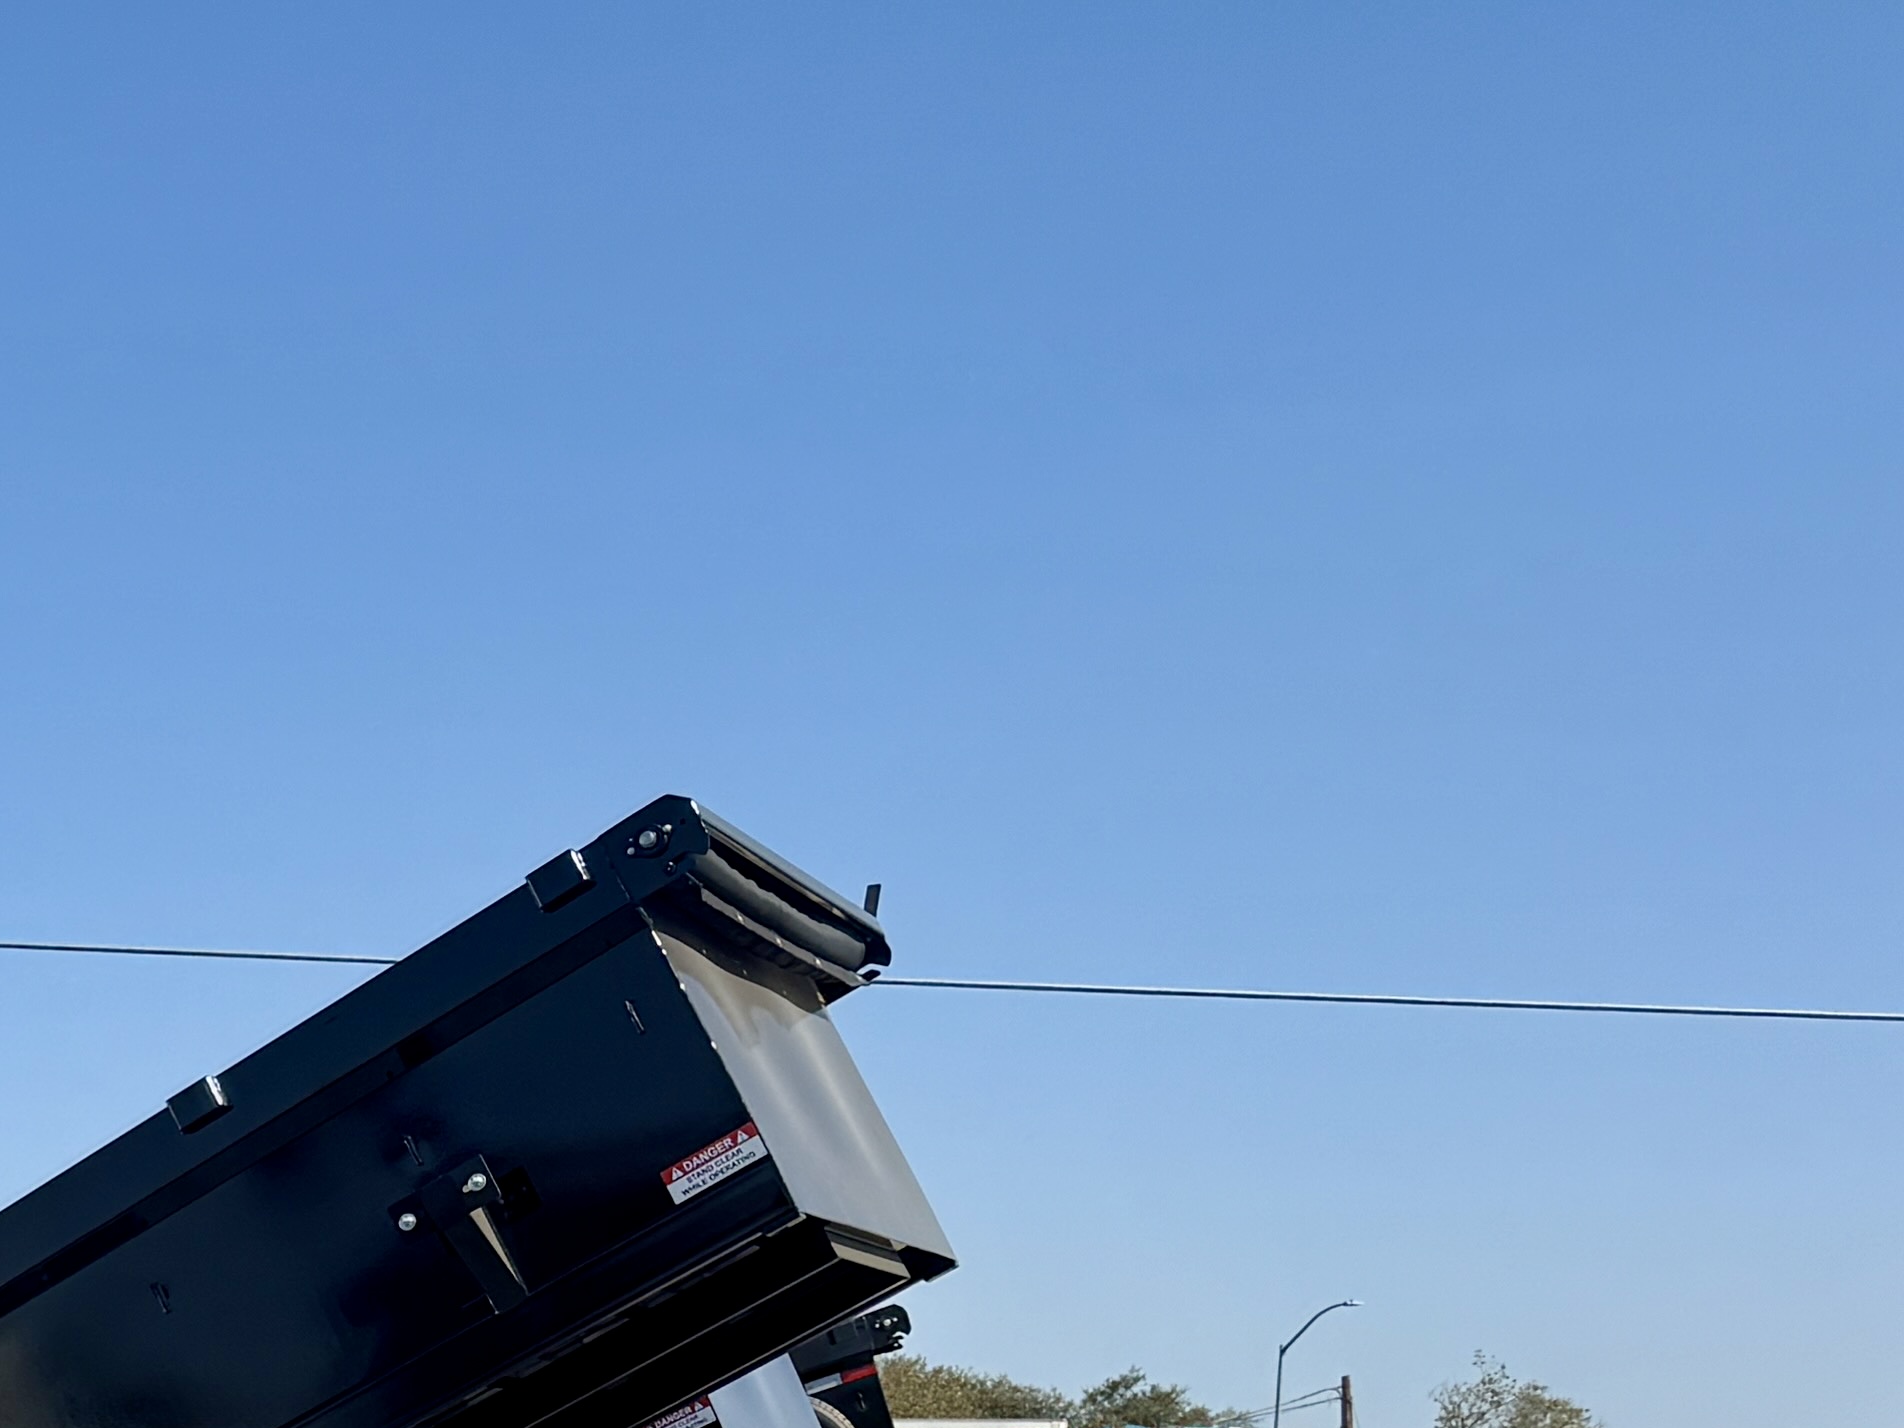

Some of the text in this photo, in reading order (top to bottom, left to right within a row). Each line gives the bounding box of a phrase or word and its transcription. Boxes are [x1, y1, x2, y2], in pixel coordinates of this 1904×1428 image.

[682, 1137, 735, 1172] DANGER
[686, 1147, 743, 1184] STAND CLEAR
[681, 1151, 756, 1196] WHILE OPERATING
